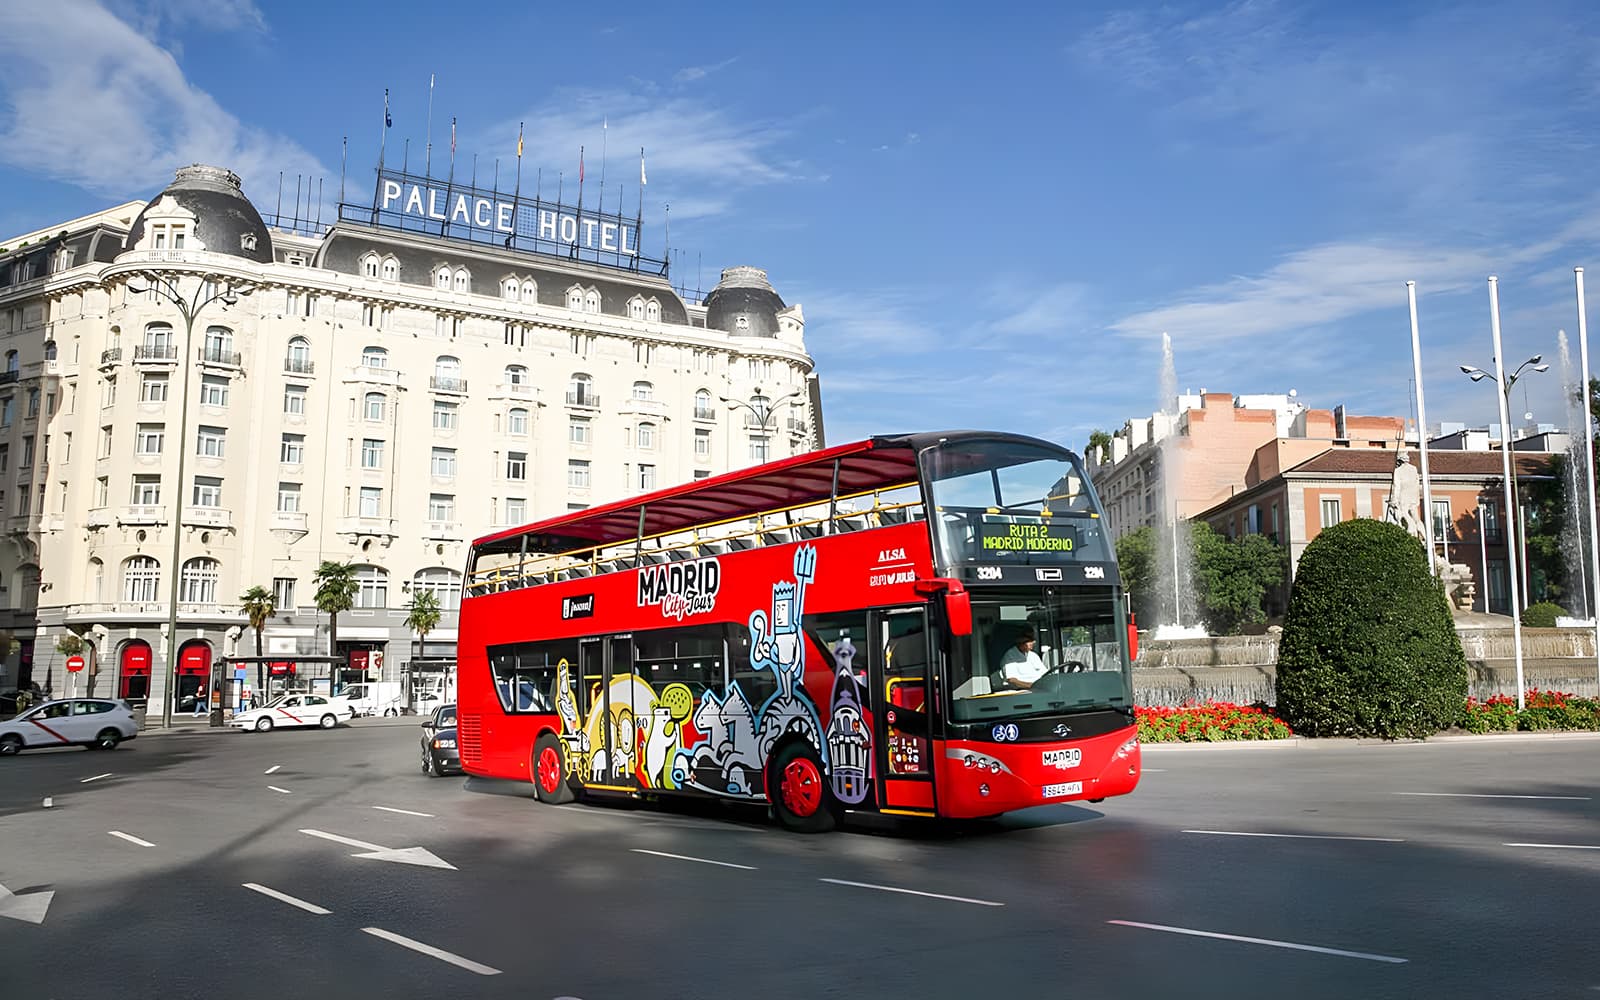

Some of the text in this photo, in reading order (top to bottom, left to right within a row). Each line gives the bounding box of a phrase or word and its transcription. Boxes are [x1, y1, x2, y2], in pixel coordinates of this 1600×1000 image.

[382, 180, 638, 255] PALACE HOTEL
[1009, 524, 1048, 538] RUTA 2
[983, 536, 1073, 551] MADRID MODERNO
[877, 547, 907, 562] ALSA
[638, 559, 719, 605] MADRID
[664, 590, 714, 619] City Tour
[1044, 750, 1080, 764] MADRID
